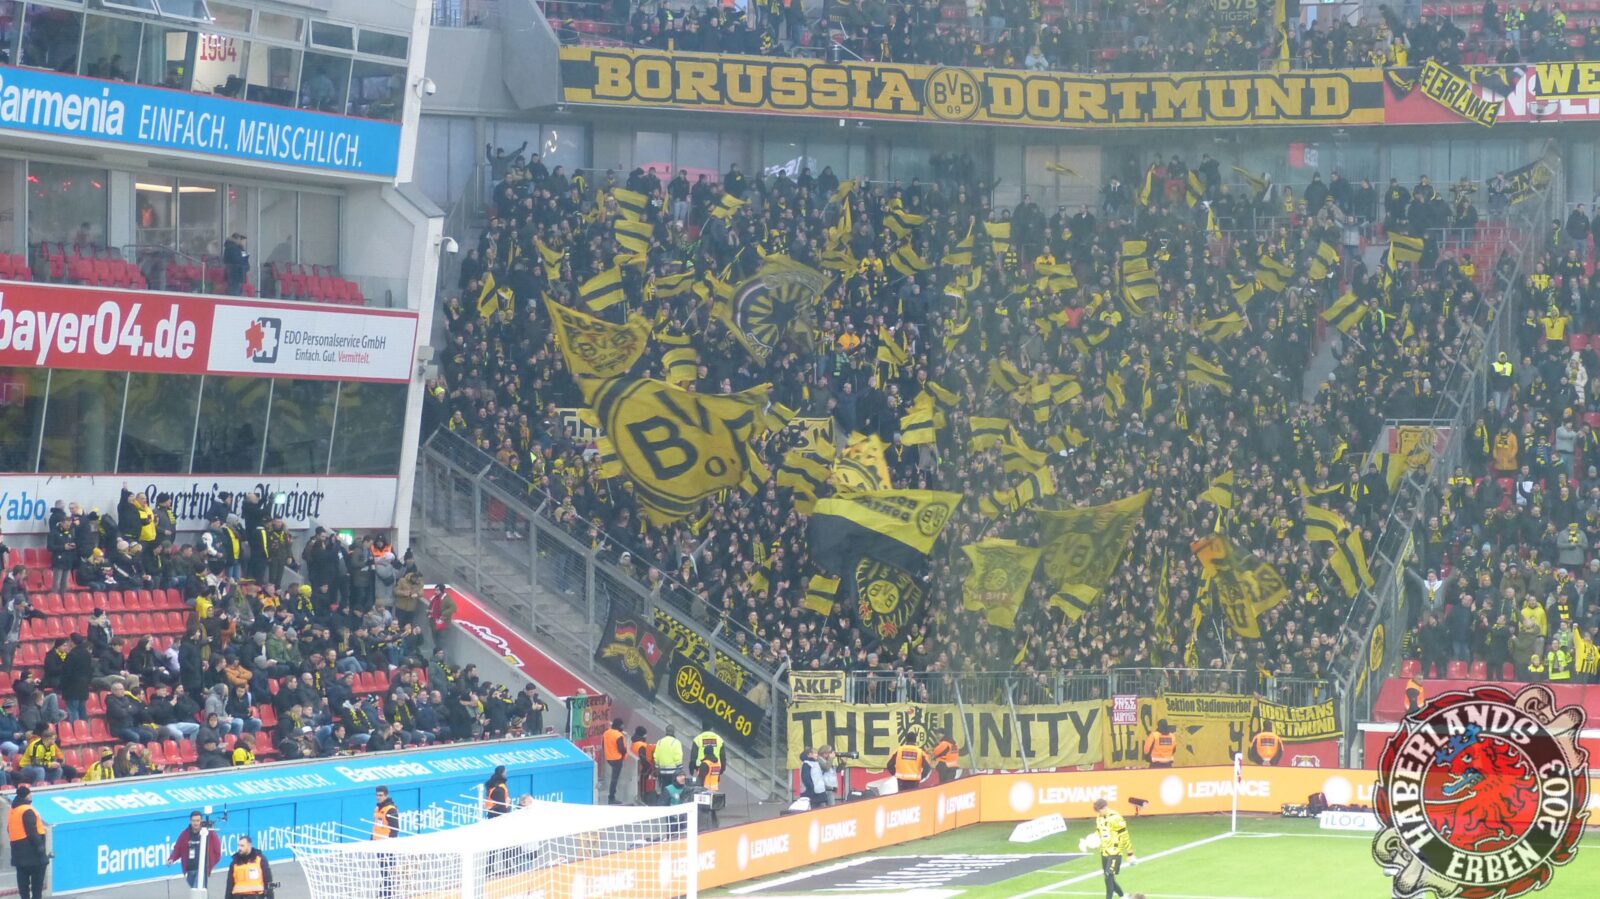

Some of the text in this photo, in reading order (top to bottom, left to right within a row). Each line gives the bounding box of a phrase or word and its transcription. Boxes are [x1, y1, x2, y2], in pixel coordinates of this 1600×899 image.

[200, 33, 237, 62] 1904
[594, 56, 921, 112] BORUSSIA
[934, 73, 974, 105] BVB
[988, 75, 1351, 120] DORTMUND
[946, 105, 962, 115] 09
[138, 105, 229, 150] EINFACH.
[237, 119, 363, 168] MENSCHLICH.
[284, 330, 386, 350] EDO Personalservice GmbH
[295, 348, 321, 362] Einfach.
[794, 679, 843, 694] AKLP
[1166, 697, 1195, 712] Sektion
[735, 715, 752, 736] 80
[792, 708, 1099, 759] THE UNITY
[335, 747, 570, 783] Barmenia EINFACH. MENSCHLICH.
[51, 773, 337, 815] Barmenia EINFACH. MENSCHLICH.
[1038, 785, 1118, 804] LEDVANCE
[1187, 780, 1271, 800] LEDVANCE
[946, 791, 976, 815] LEDVANCE
[886, 805, 921, 829] LEDVANCE
[820, 819, 857, 843] LEDVANCE
[97, 835, 181, 875] Barmeni
[750, 834, 790, 860] LEDVANCE
